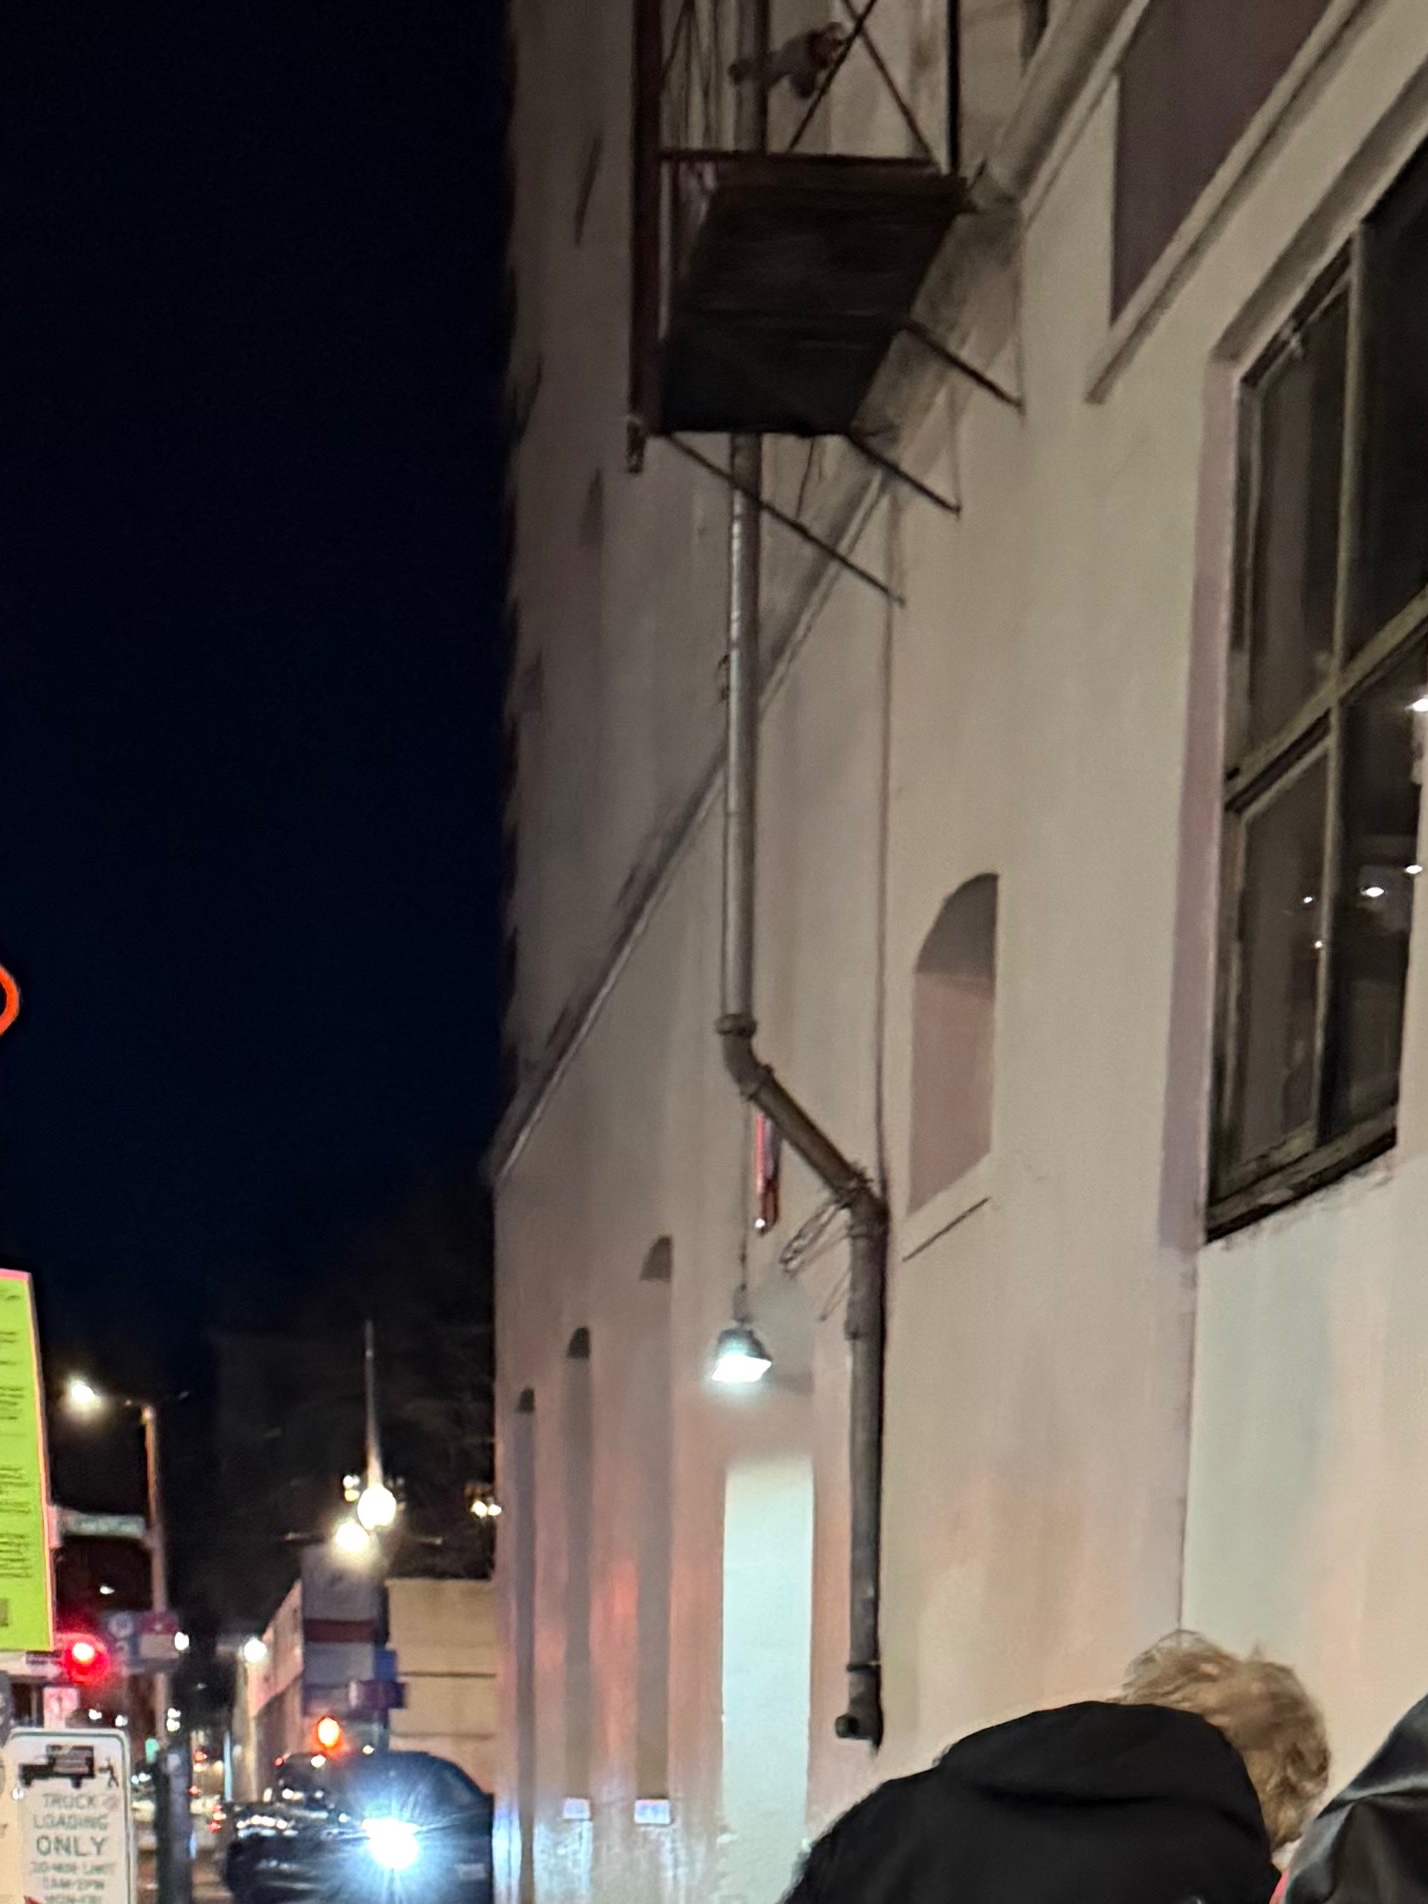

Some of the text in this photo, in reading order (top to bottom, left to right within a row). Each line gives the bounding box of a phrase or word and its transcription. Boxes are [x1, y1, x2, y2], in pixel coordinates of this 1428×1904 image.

[42, 1793, 96, 1809] TRUCK
[33, 1813, 109, 1831] LOADING
[36, 1834, 107, 1857] ONLY
